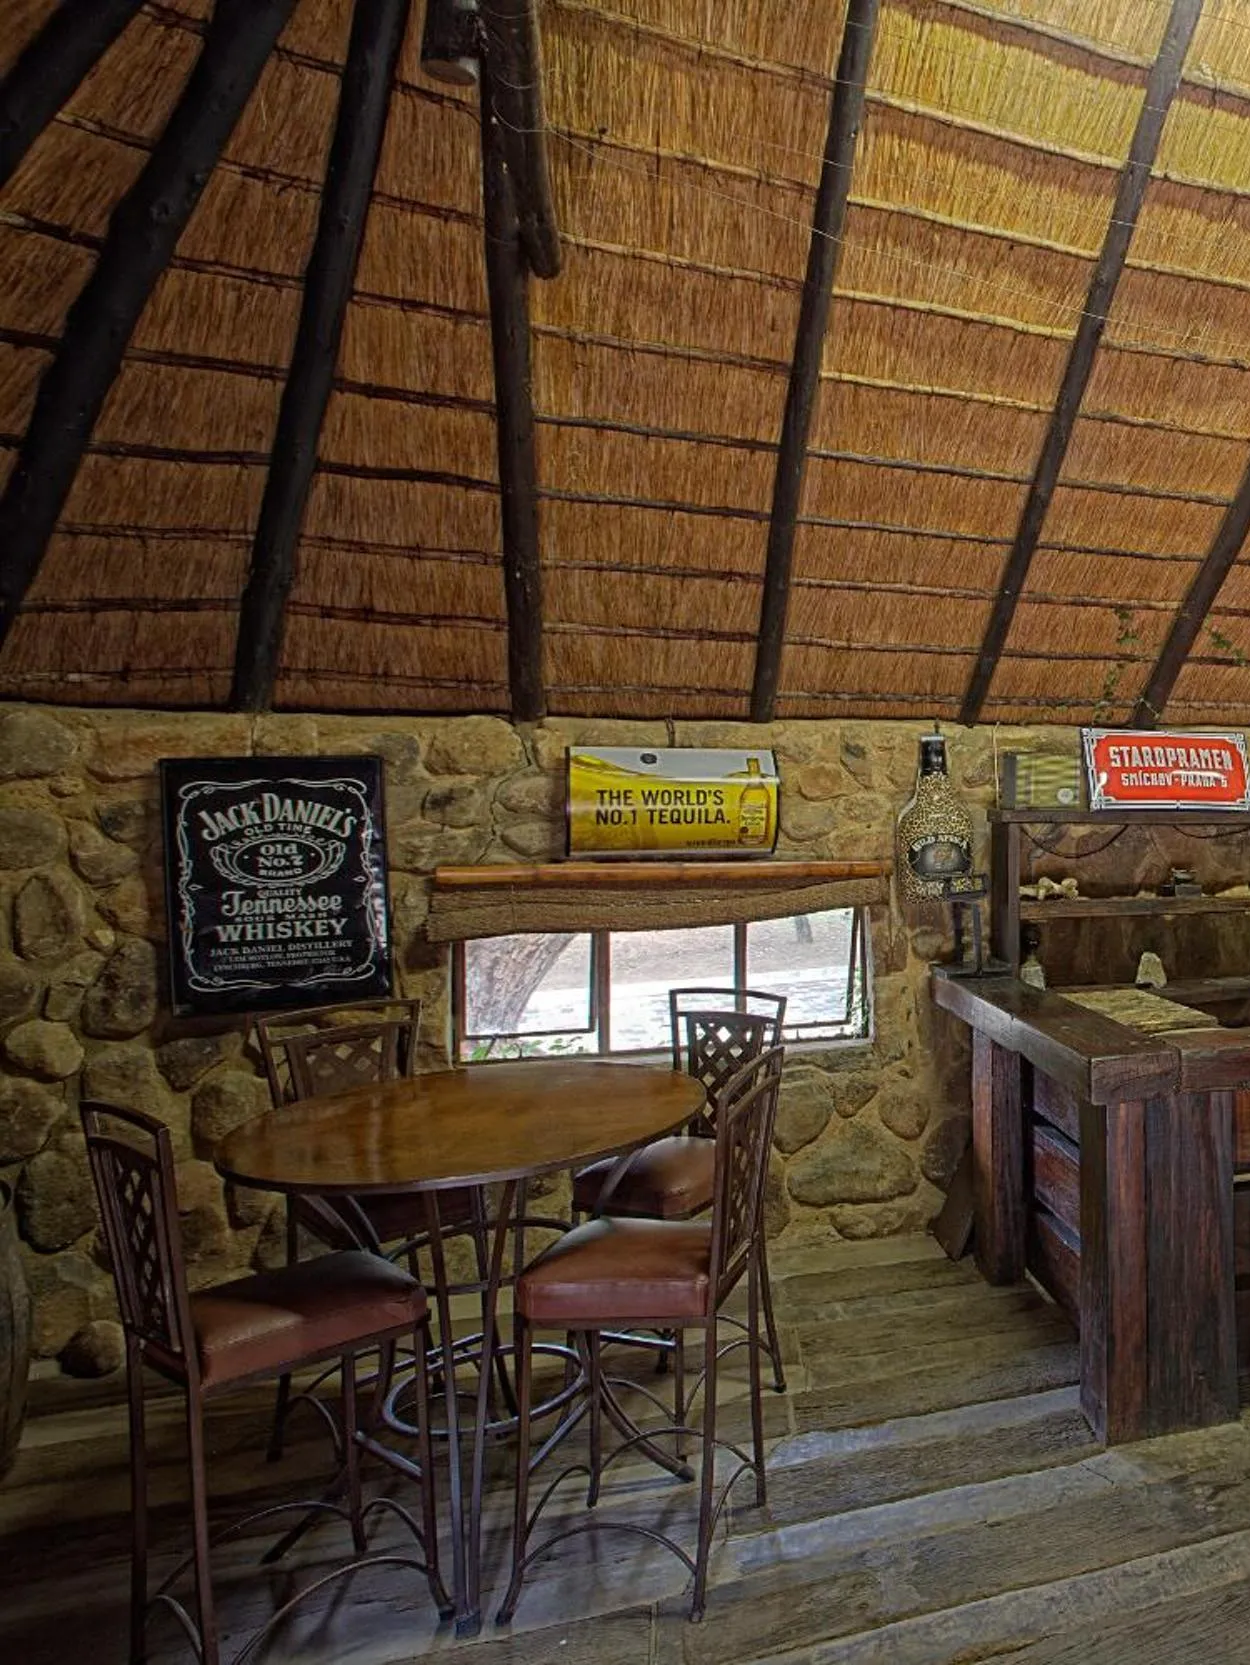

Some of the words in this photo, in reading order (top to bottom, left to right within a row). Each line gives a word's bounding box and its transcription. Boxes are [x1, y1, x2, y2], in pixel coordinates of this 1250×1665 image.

[1109, 745, 1233, 771] STAROPRAMEN
[597, 789, 634, 806] THE
[641, 789, 724, 806] WORLD'S
[198, 801, 260, 841] JACK
[262, 792, 358, 838] DANIEL'S
[648, 808, 731, 826] TEQUILA.
[243, 823, 274, 836] OLD
[277, 823, 313, 834] TIME
[260, 843, 299, 856] Old
[256, 888, 303, 899] QUALITY
[221, 891, 343, 917] Tennessee
[214, 917, 349, 942] WHISKEY
